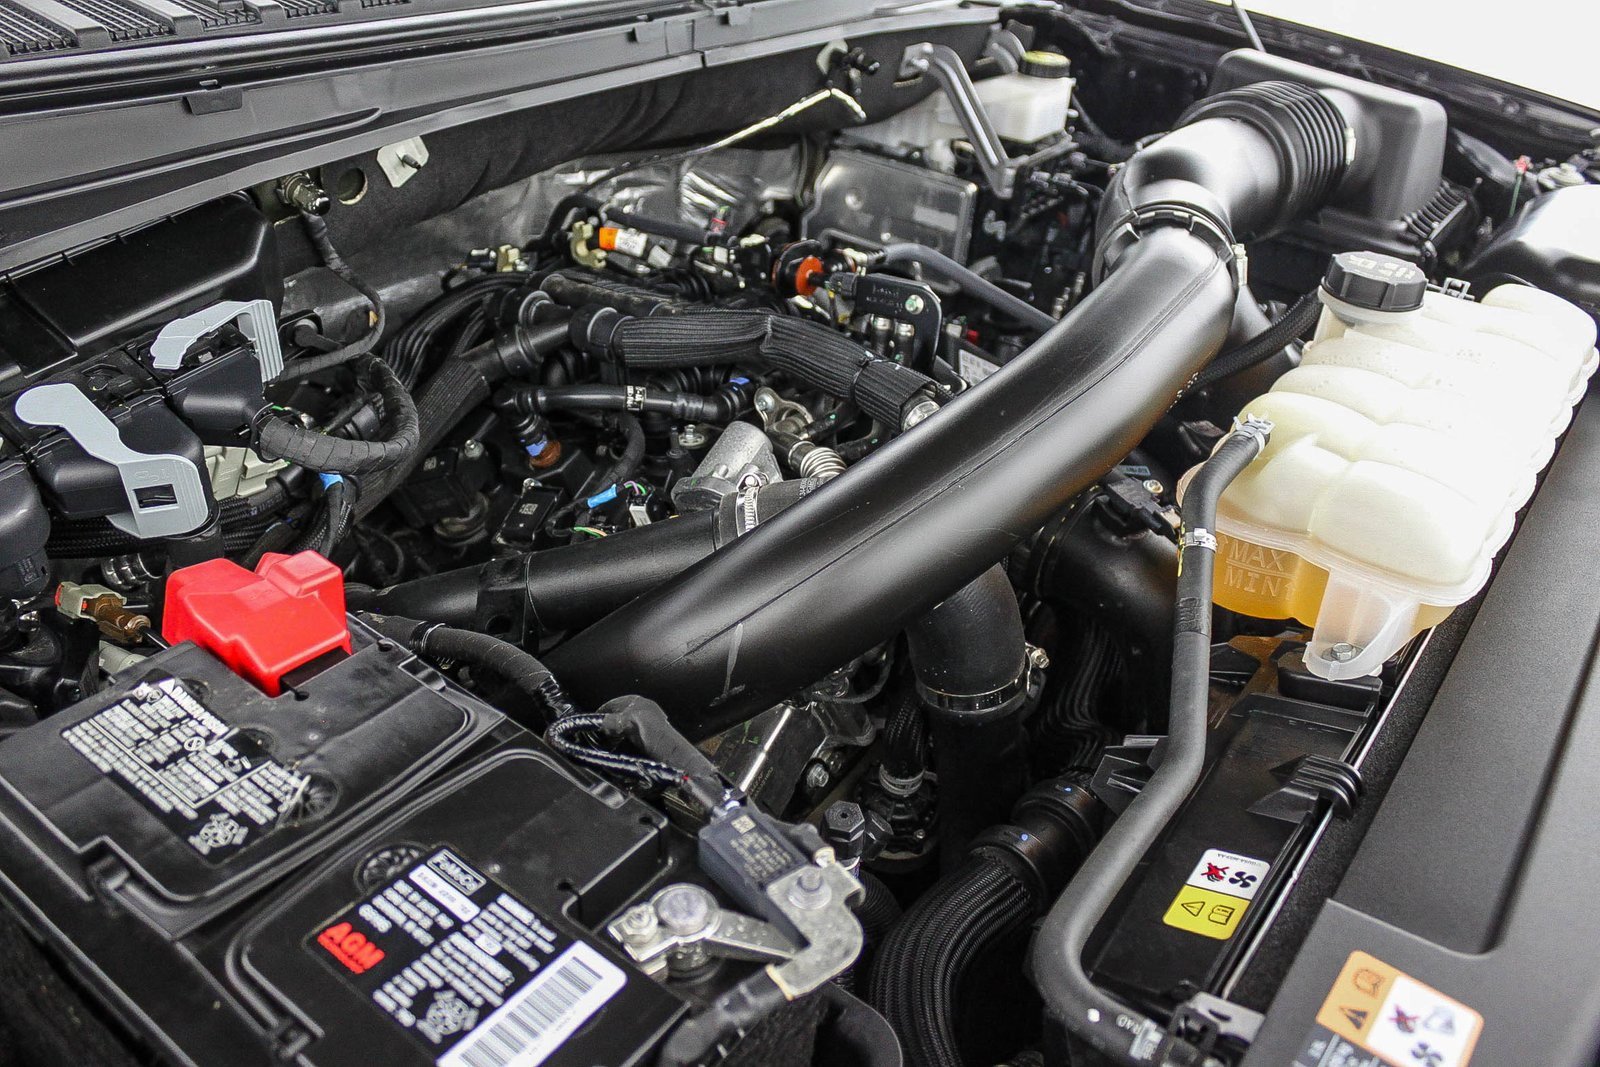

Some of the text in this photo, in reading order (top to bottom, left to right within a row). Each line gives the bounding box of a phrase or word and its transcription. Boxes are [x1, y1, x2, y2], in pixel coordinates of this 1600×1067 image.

[1228, 539, 1288, 571] MAX
[1223, 566, 1282, 597] MIN
[322, 922, 385, 971] AGM
